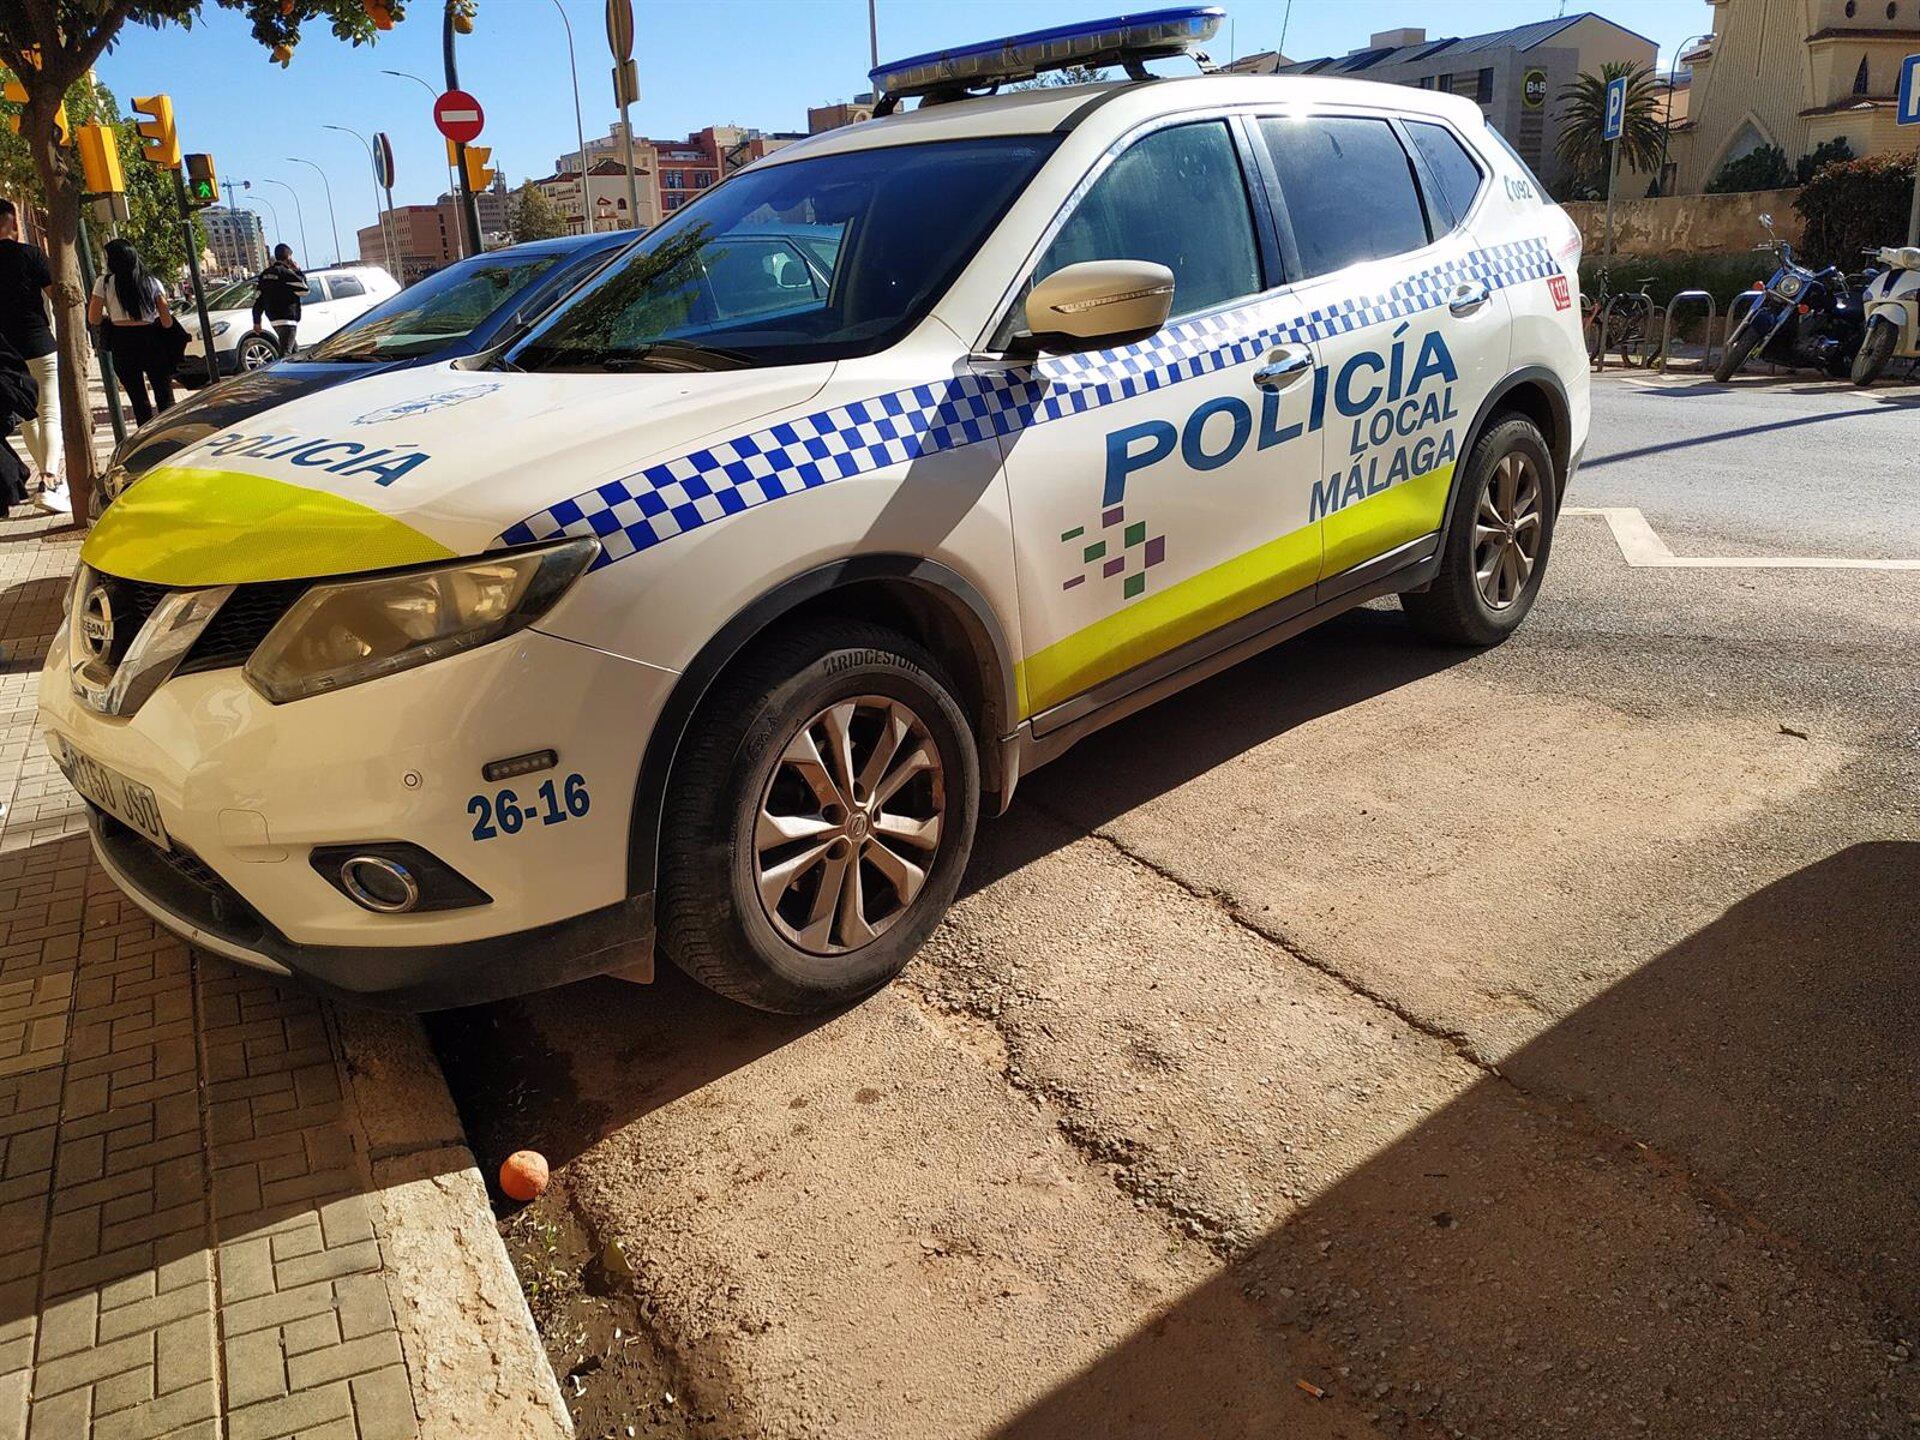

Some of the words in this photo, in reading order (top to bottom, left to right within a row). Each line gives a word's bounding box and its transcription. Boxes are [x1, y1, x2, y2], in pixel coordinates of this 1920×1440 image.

[1526, 81, 1547, 93] B&B
[1608, 87, 1620, 132] P
[1511, 180, 1533, 200] 092
[1102, 321, 1458, 508] POLICÍA
[1349, 388, 1458, 456] LOCAL
[1308, 428, 1456, 523] MÁLAGA
[122, 780, 159, 837] JSD
[467, 772, 590, 842] 26-16
